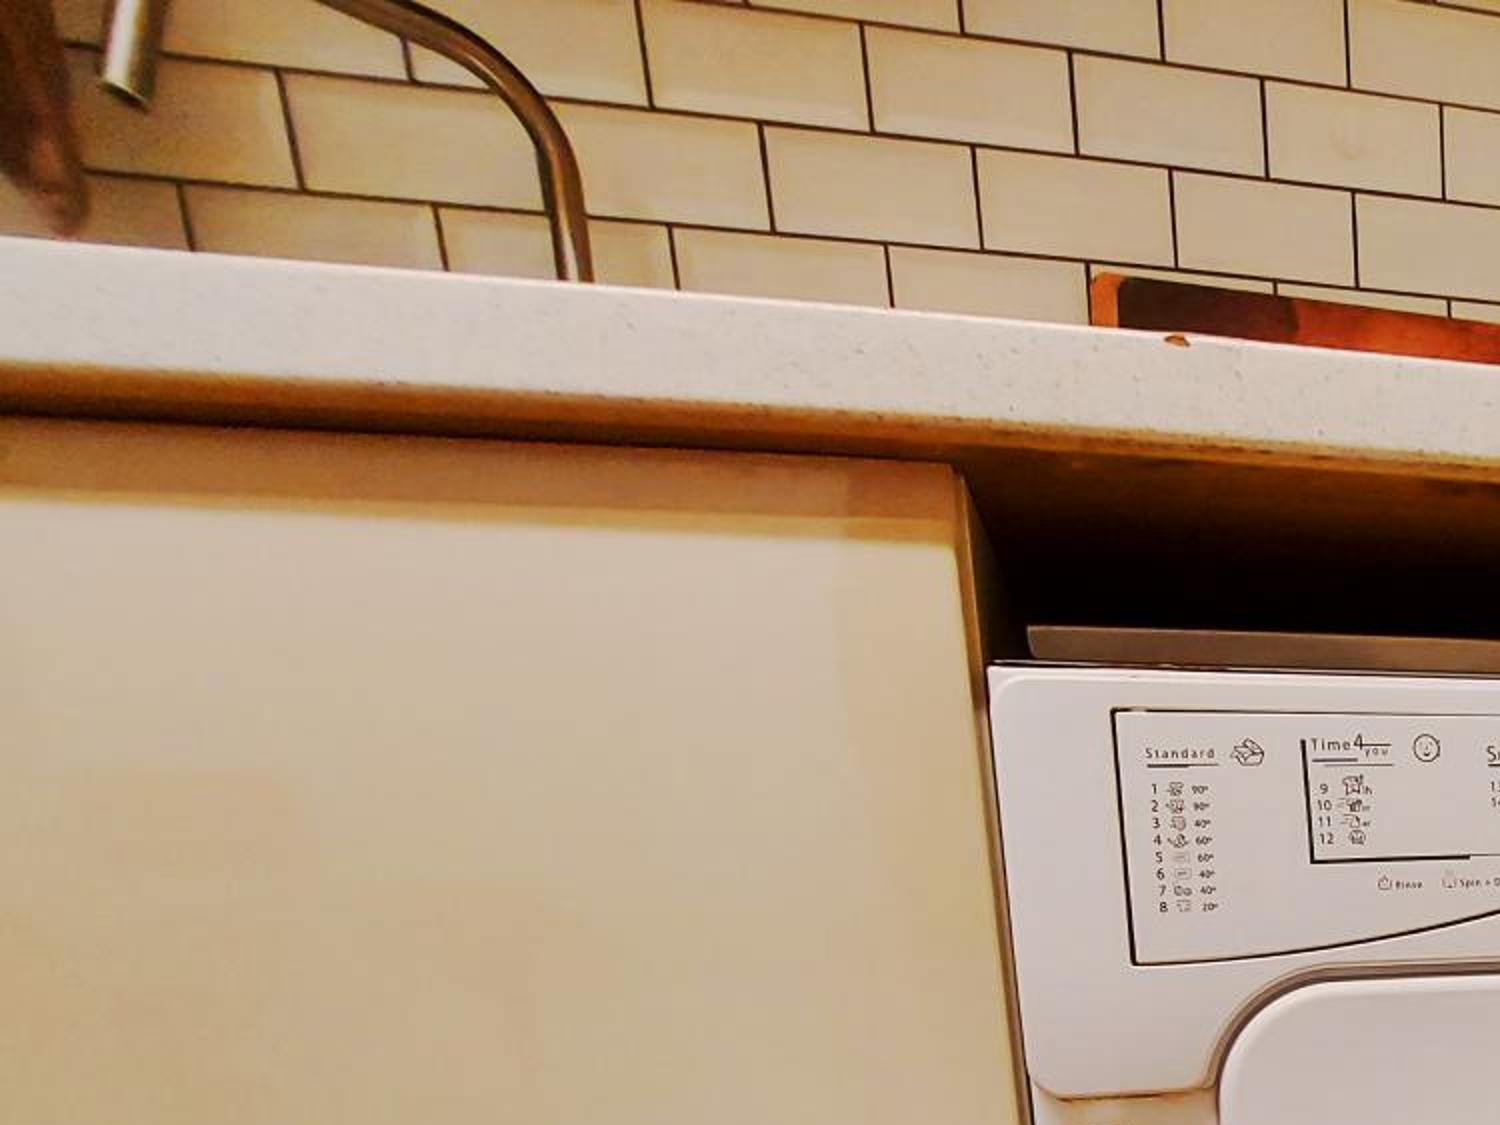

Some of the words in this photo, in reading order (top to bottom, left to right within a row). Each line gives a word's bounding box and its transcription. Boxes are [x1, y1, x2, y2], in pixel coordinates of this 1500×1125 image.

[1145, 747, 1216, 760] Standard
[1319, 783, 1329, 795] 9
[1151, 799, 1159, 813] 2
[1317, 799, 1332, 811] 10
[1152, 817, 1161, 829] 3
[1318, 815, 1331, 827] 11
[1153, 834, 1162, 846] 4
[1319, 831, 1335, 845] 12
[1155, 851, 1163, 863] 5
[1156, 867, 1165, 881] 6
[1159, 884, 1167, 897] 7
[1159, 901, 1169, 913] 8
